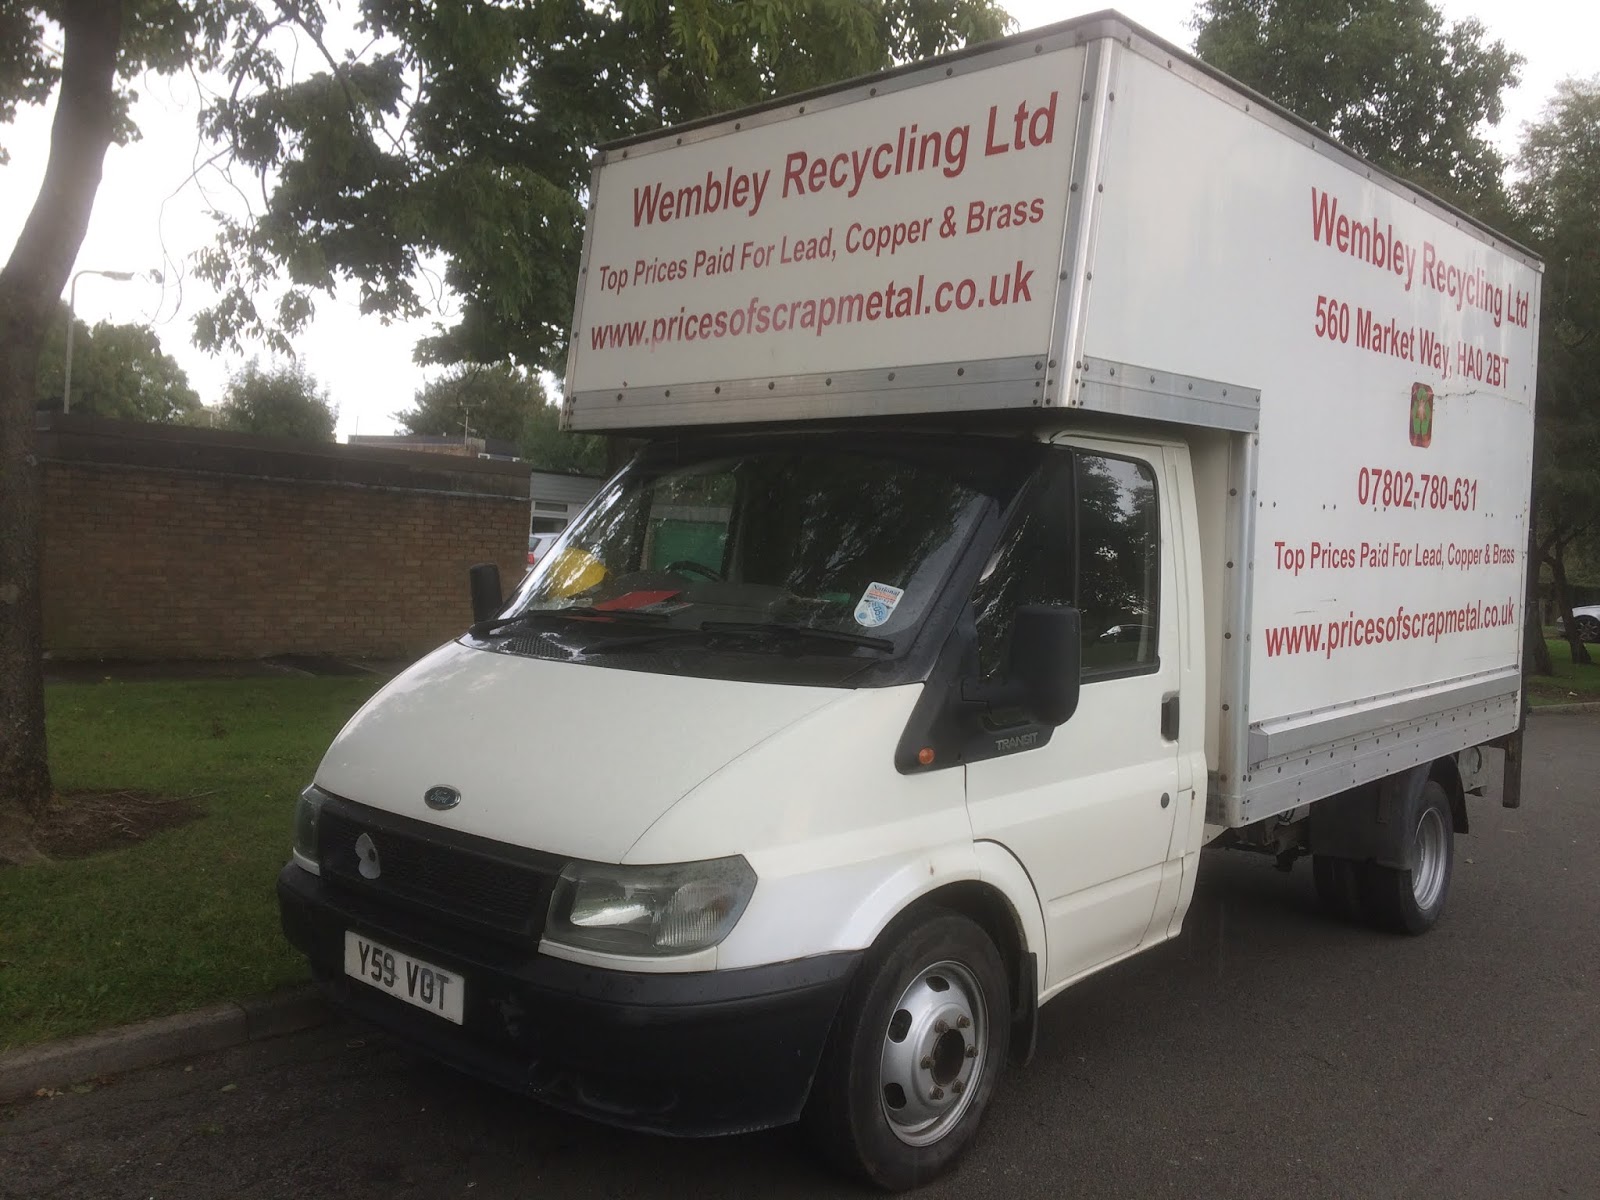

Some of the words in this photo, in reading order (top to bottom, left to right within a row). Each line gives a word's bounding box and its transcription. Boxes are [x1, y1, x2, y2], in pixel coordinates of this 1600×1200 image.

[633, 166, 770, 227] Wembley
[782, 124, 970, 198] Recycling
[984, 91, 1058, 157] Ltd
[599, 265, 628, 295] Top
[633, 255, 687, 287] Prices
[693, 246, 734, 279] Paid
[740, 240, 775, 270] For
[780, 228, 836, 265] Lead,
[845, 214, 932, 258] Copper
[939, 206, 957, 238] &
[966, 197, 1044, 234] Brass
[1311, 187, 1416, 291] Wembley
[1423, 241, 1502, 328] Recycling
[1507, 284, 1529, 328] Ltd
[591, 260, 1034, 353] www.pricesofscrapmetal.co.uk
[1315, 295, 1349, 344] 560
[1356, 307, 1415, 362] Market
[1420, 328, 1452, 380] Way,
[1486, 352, 1509, 389] 2BT
[1358, 467, 1477, 511] 07802-780-631
[1275, 542, 1305, 576] Top
[1310, 542, 1355, 568] Prices
[1360, 542, 1388, 568] Paid
[1392, 543, 1412, 567] For
[1415, 543, 1444, 569] Lead,
[1448, 544, 1482, 571] Copper
[1485, 544, 1490, 564] &
[1493, 544, 1515, 564] Brass
[1266, 597, 1514, 659] www.pricesofscrapmetal.co.uk
[995, 732, 1038, 750] TRANSIT
[358, 941, 396, 988] Y59
